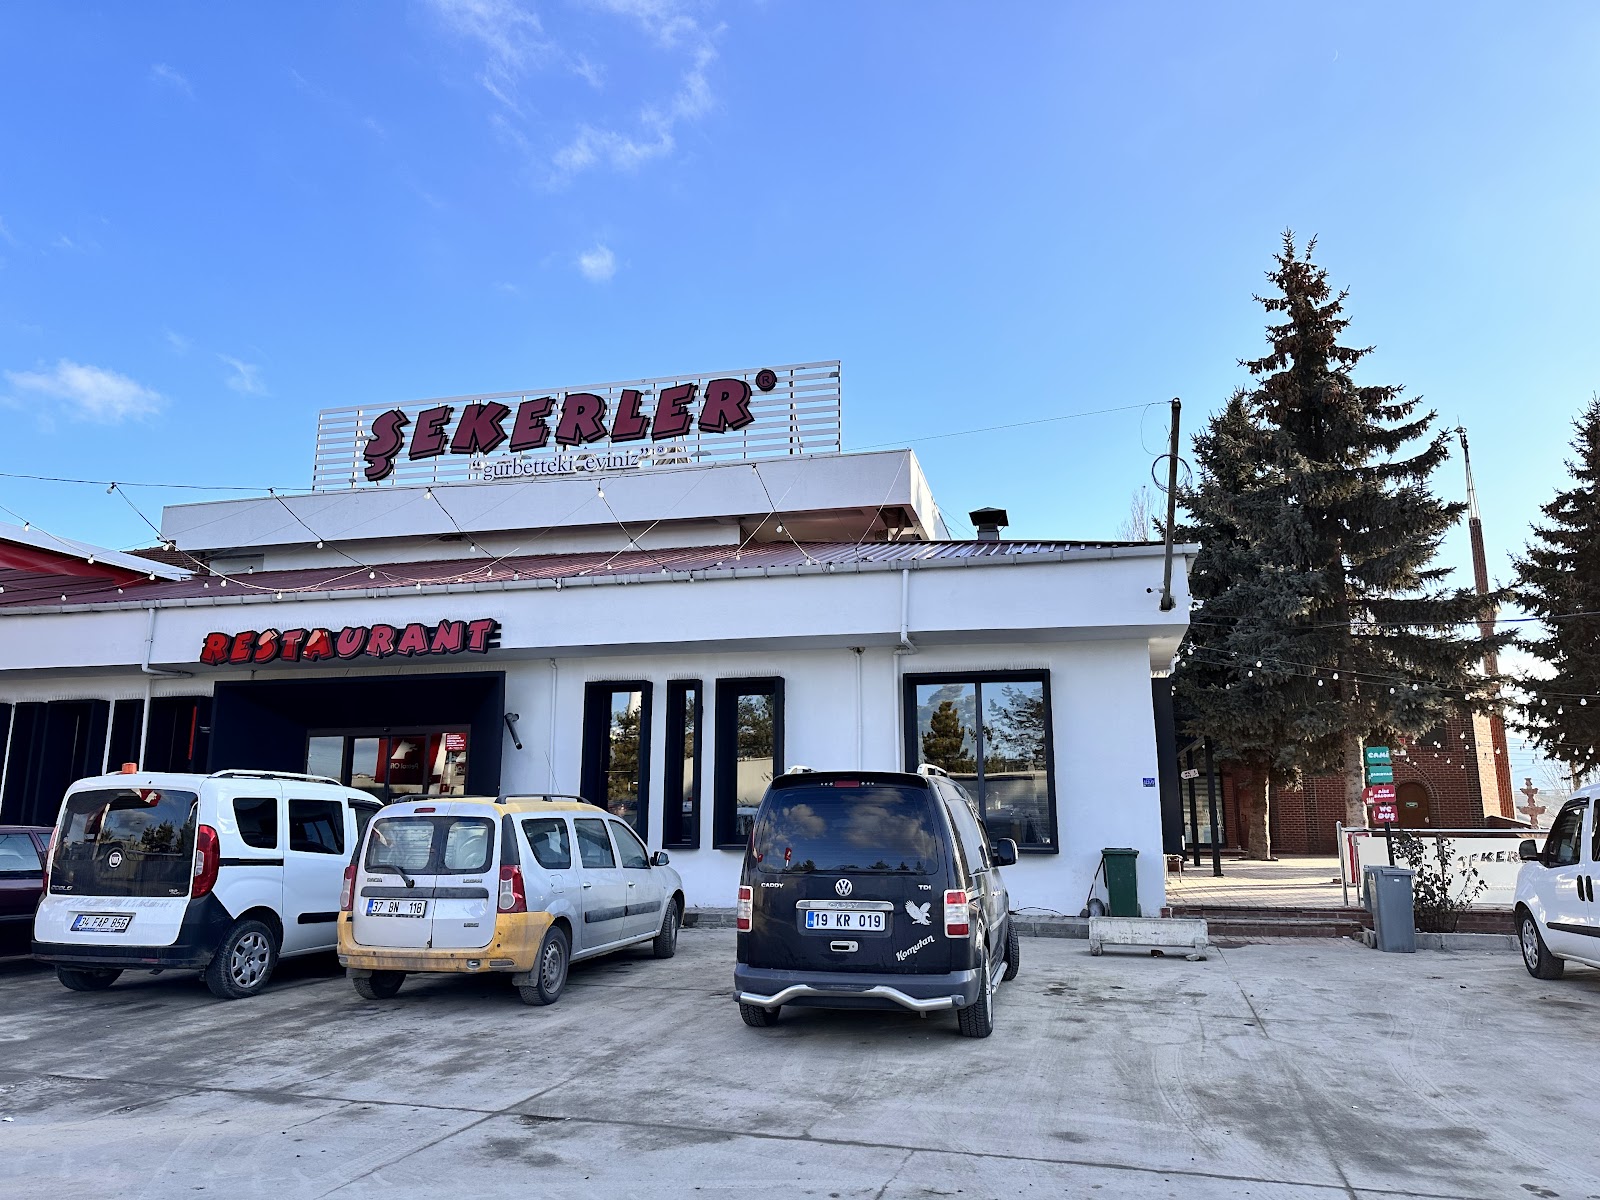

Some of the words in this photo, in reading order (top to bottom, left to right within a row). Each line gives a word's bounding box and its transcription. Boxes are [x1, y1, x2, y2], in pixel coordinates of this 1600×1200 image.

[363, 377, 755, 482] ŞEKERLER
[200, 618, 498, 666] RESTAURANT
[1378, 813, 1395, 821] DUŞ
[372, 901, 384, 913] 37
[388, 901, 400, 913] BN
[409, 902, 423, 914] 118
[79, 917, 90, 927] 34
[91, 917, 109, 928] FAP
[814, 913, 828, 927] 19
[836, 914, 851, 927] KR
[859, 914, 881, 928] 019
[895, 934, 936, 962] Komutan
